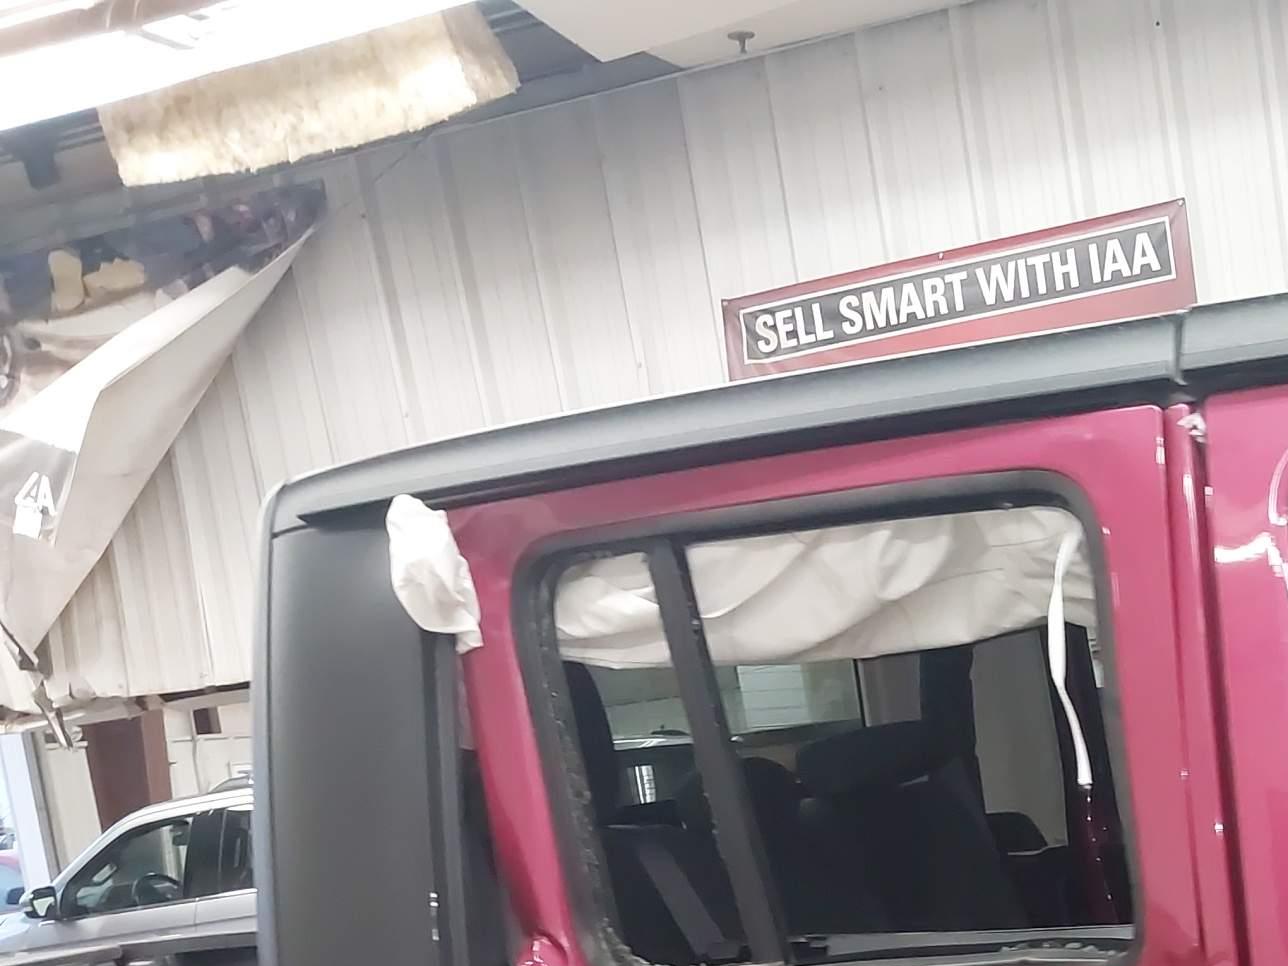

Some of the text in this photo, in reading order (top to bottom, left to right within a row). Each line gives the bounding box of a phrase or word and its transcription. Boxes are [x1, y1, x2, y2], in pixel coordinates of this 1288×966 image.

[754, 232, 1162, 354] SELL SMART WITH IAA
